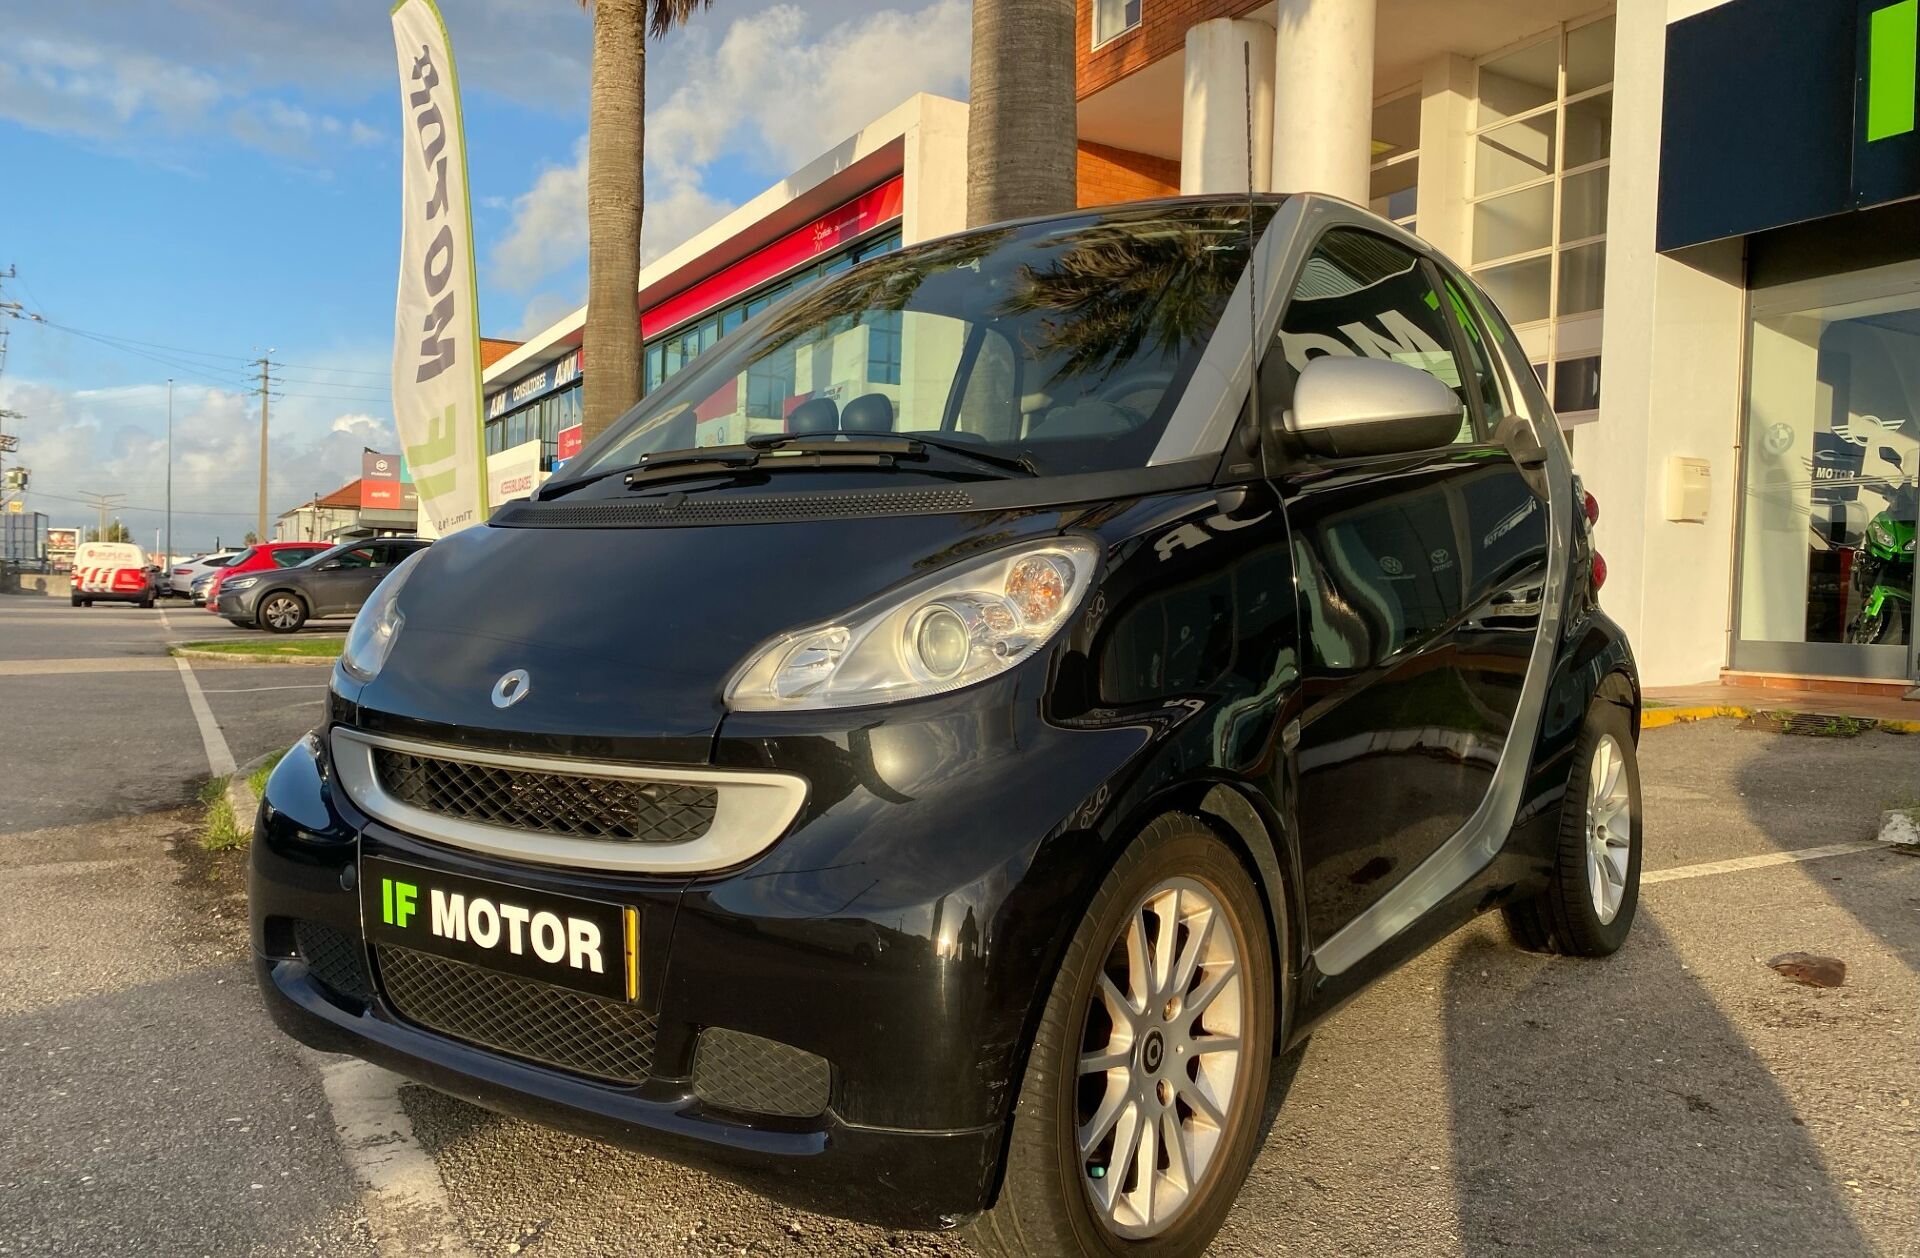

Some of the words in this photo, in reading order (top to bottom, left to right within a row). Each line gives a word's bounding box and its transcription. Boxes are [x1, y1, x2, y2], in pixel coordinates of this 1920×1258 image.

[512, 372, 547, 402] CONSULTORES
[1816, 467, 1855, 480] MOTOR
[383, 878, 418, 928] IF
[430, 889, 604, 974] MOTOR
